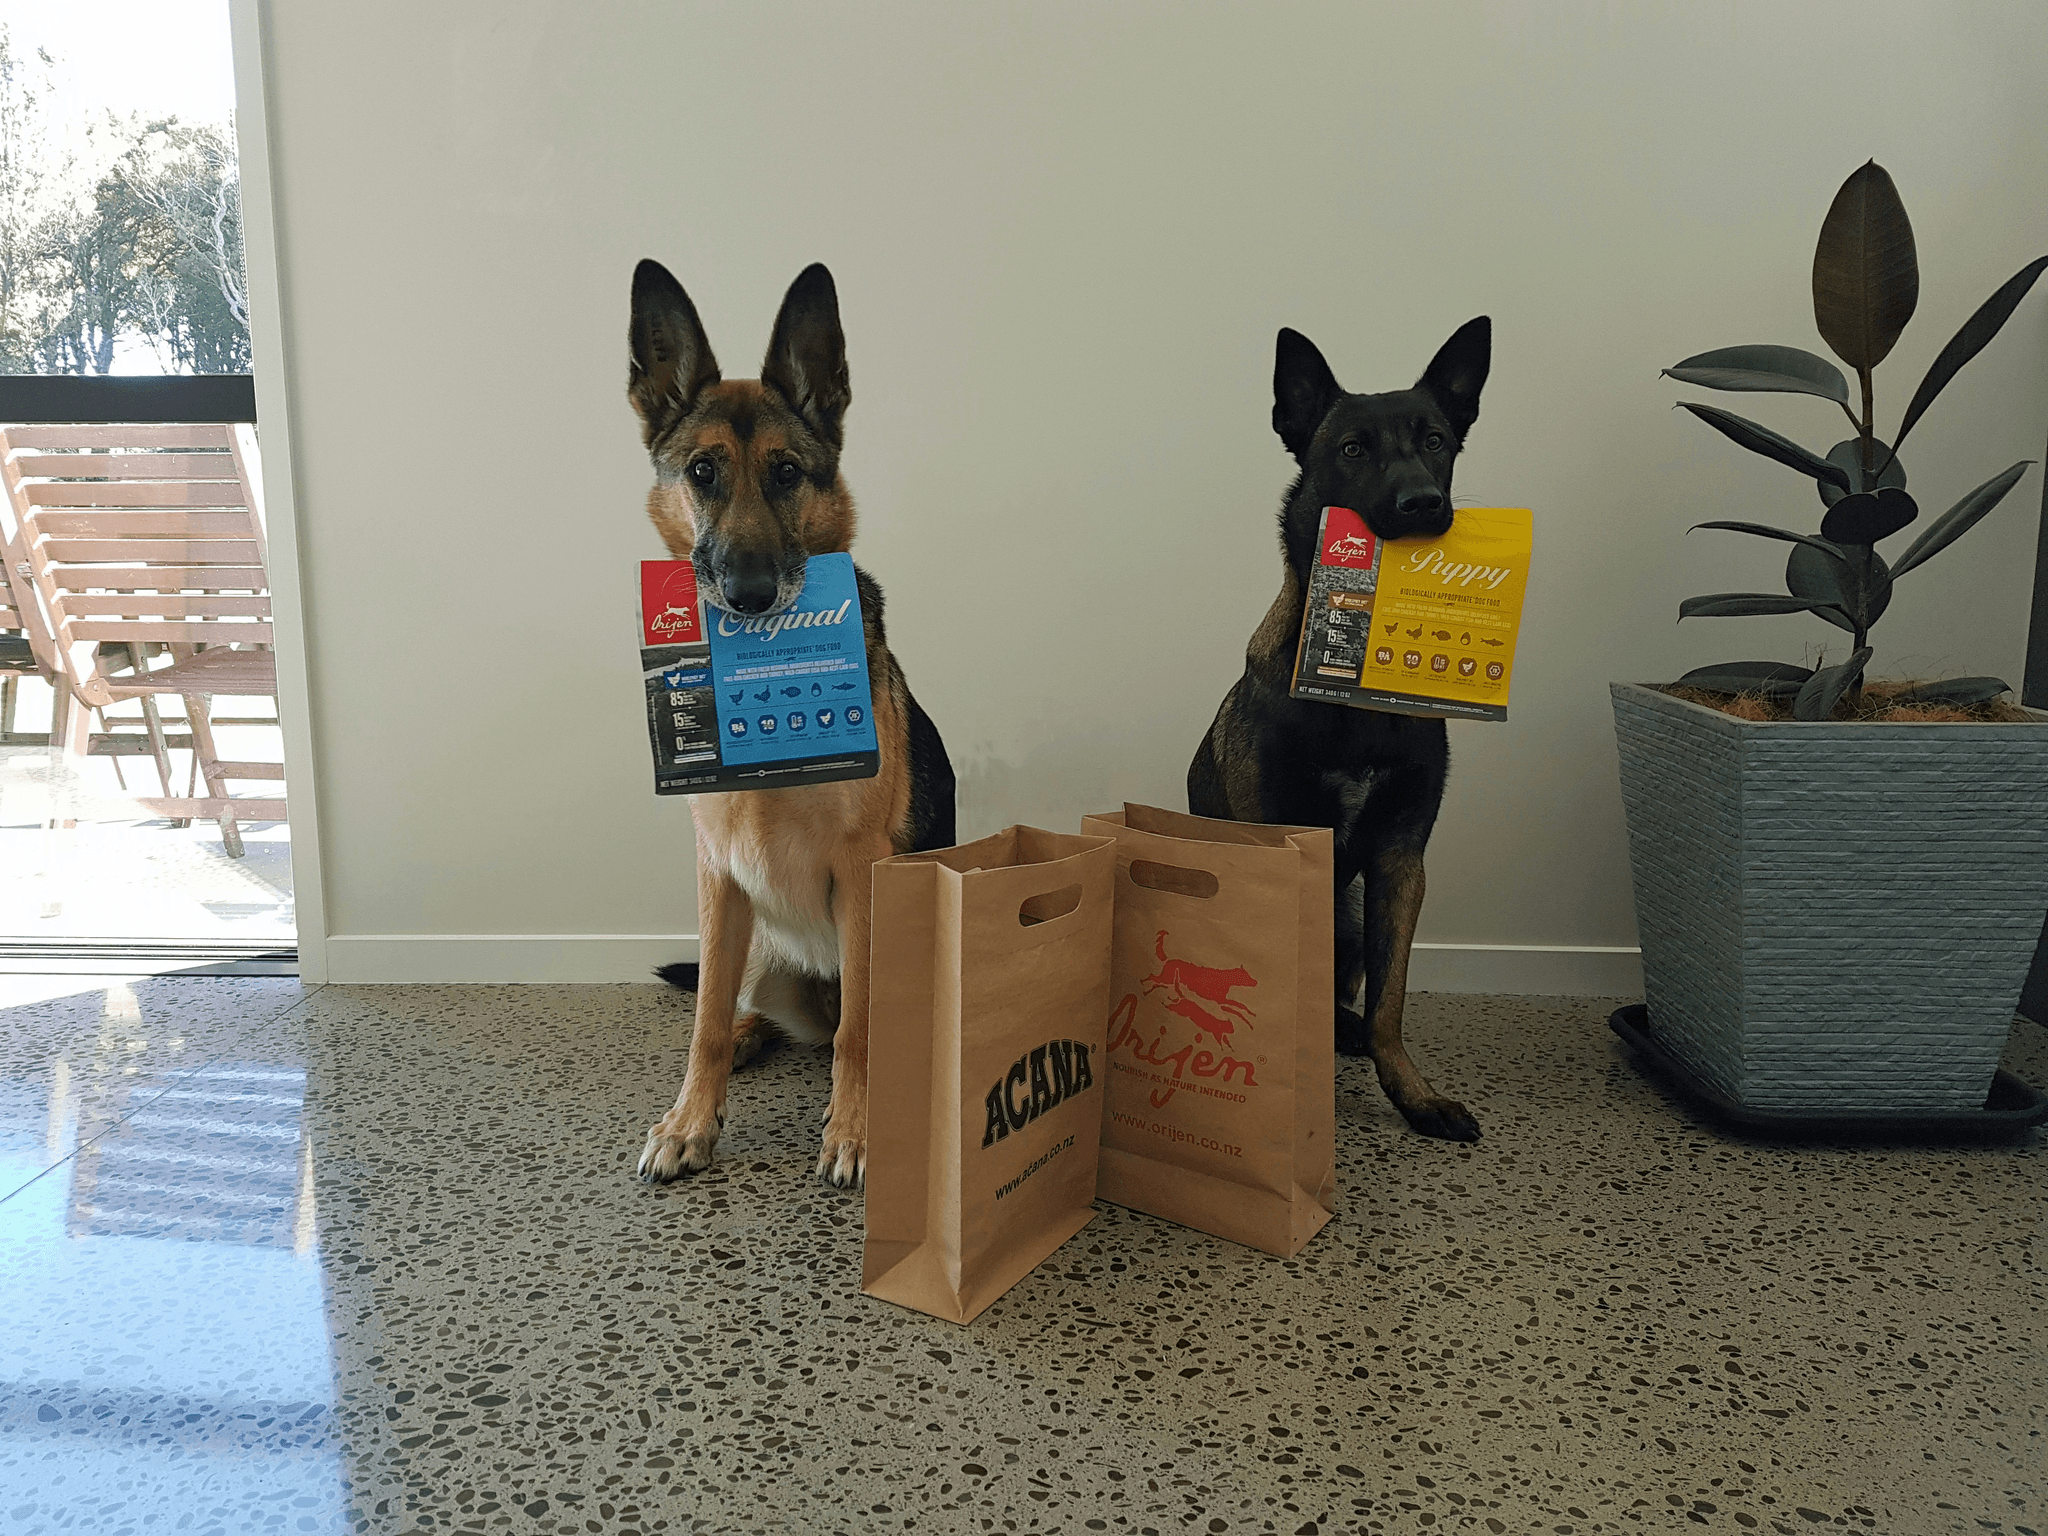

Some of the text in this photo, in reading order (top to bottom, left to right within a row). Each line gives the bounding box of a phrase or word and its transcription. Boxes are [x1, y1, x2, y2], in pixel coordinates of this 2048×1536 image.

[1328, 540, 1367, 563] Orijen
[1400, 547, 1512, 590] Puppy
[1400, 587, 1436, 599] BIOLOGICALLY
[1474, 596, 1486, 606] DOG
[1486, 598, 1501, 607] FOOD
[651, 614, 693, 639] Orijen
[718, 599, 852, 642] Original
[736, 648, 775, 661] BIOLOGICALLY
[827, 641, 842, 651] FOOD
[1106, 993, 1259, 1109] Orijen
[982, 1039, 1093, 1149] ACANA
[1113, 1061, 1247, 1104] NOURISH AS NATURE INTENDED
[1112, 1111, 1243, 1158] www.orijen.co.nz
[995, 1134, 1075, 1201] www.acana.co.nz
